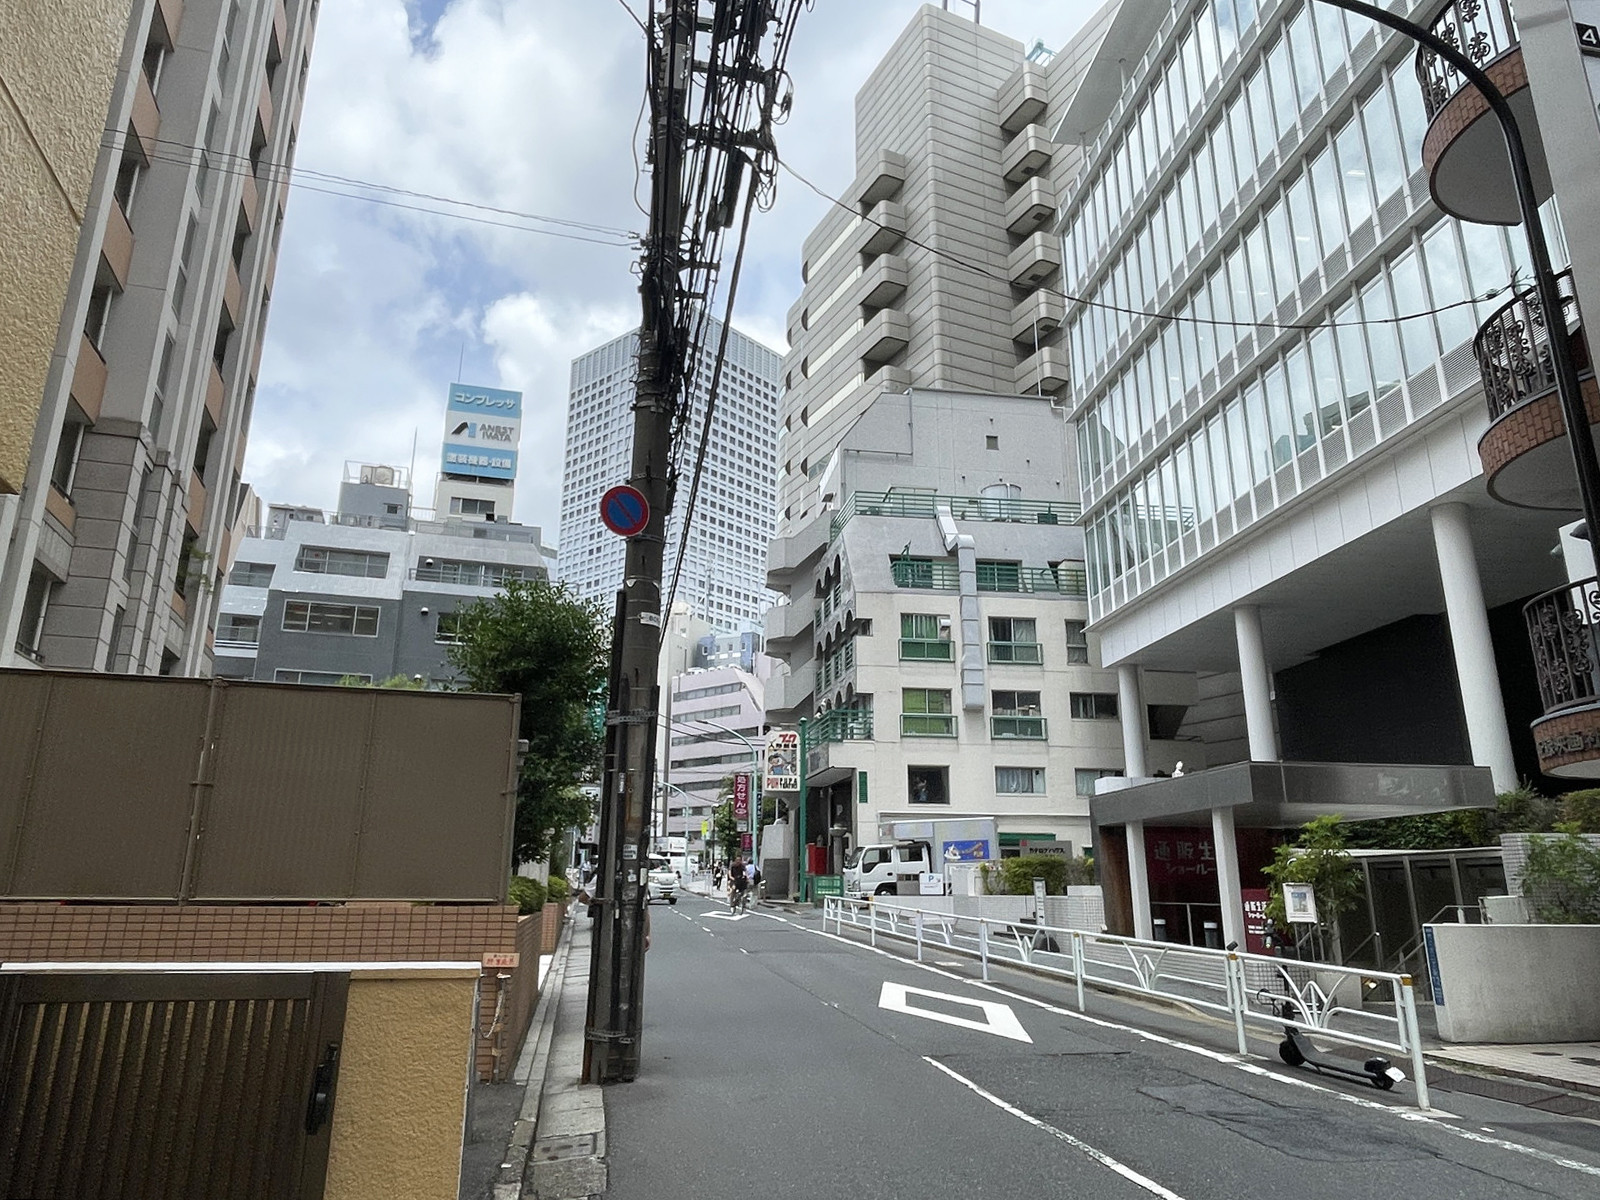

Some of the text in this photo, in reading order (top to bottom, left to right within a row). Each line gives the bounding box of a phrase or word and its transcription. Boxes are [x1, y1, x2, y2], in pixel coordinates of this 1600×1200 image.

[456, 393, 515, 409] コンプレッサ
[480, 423, 514, 434] ANEST
[482, 431, 512, 442] IWATA
[736, 776, 747, 808] 処方せん
[928, 875, 935, 883] P
